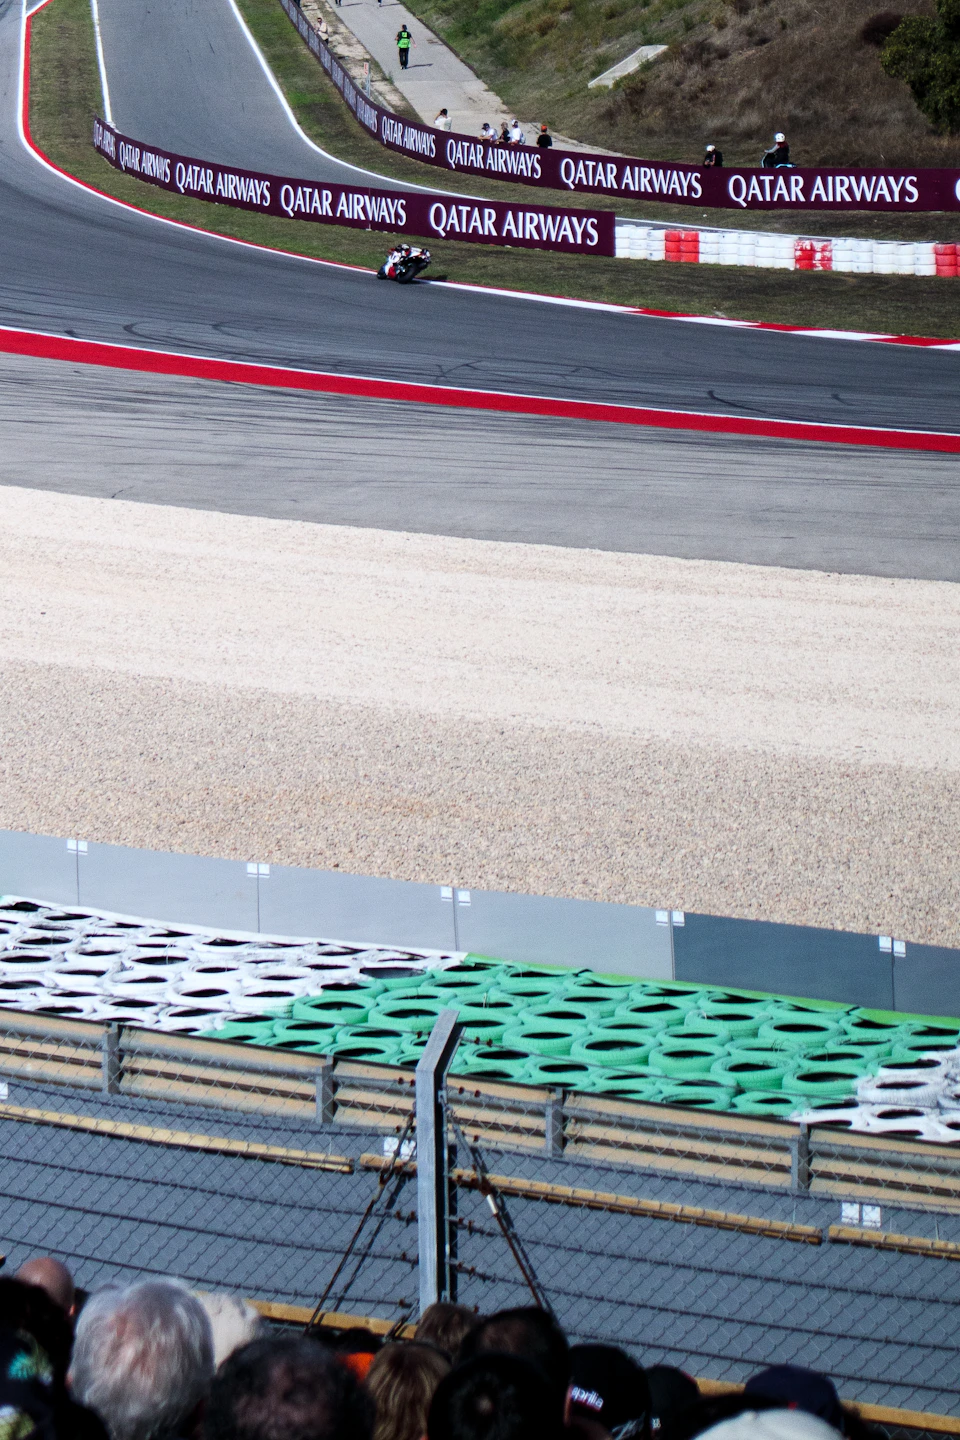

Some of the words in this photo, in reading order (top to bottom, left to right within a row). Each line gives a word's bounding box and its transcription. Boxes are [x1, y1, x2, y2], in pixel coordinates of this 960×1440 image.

[120, 141, 140, 170] QATAR
[140, 151, 170, 184] AIRWAYS
[176, 162, 214, 194] QATAR
[216, 172, 270, 206] AIRWAYS
[280, 184, 332, 217] QATAR
[336, 192, 407, 226] AIRWAYS
[430, 202, 497, 237] QATAR
[503, 211, 599, 246] AIRWAYS
[382, 116, 402, 144] QATAR
[403, 126, 436, 158] AIRWAYS
[447, 139, 484, 169] QATAR
[486, 146, 542, 179] AIRWAYS
[560, 158, 618, 190] QATAR
[622, 166, 702, 199] AIRWAYS
[728, 175, 806, 207] QATAR
[811, 175, 918, 203] AIRWAYS
